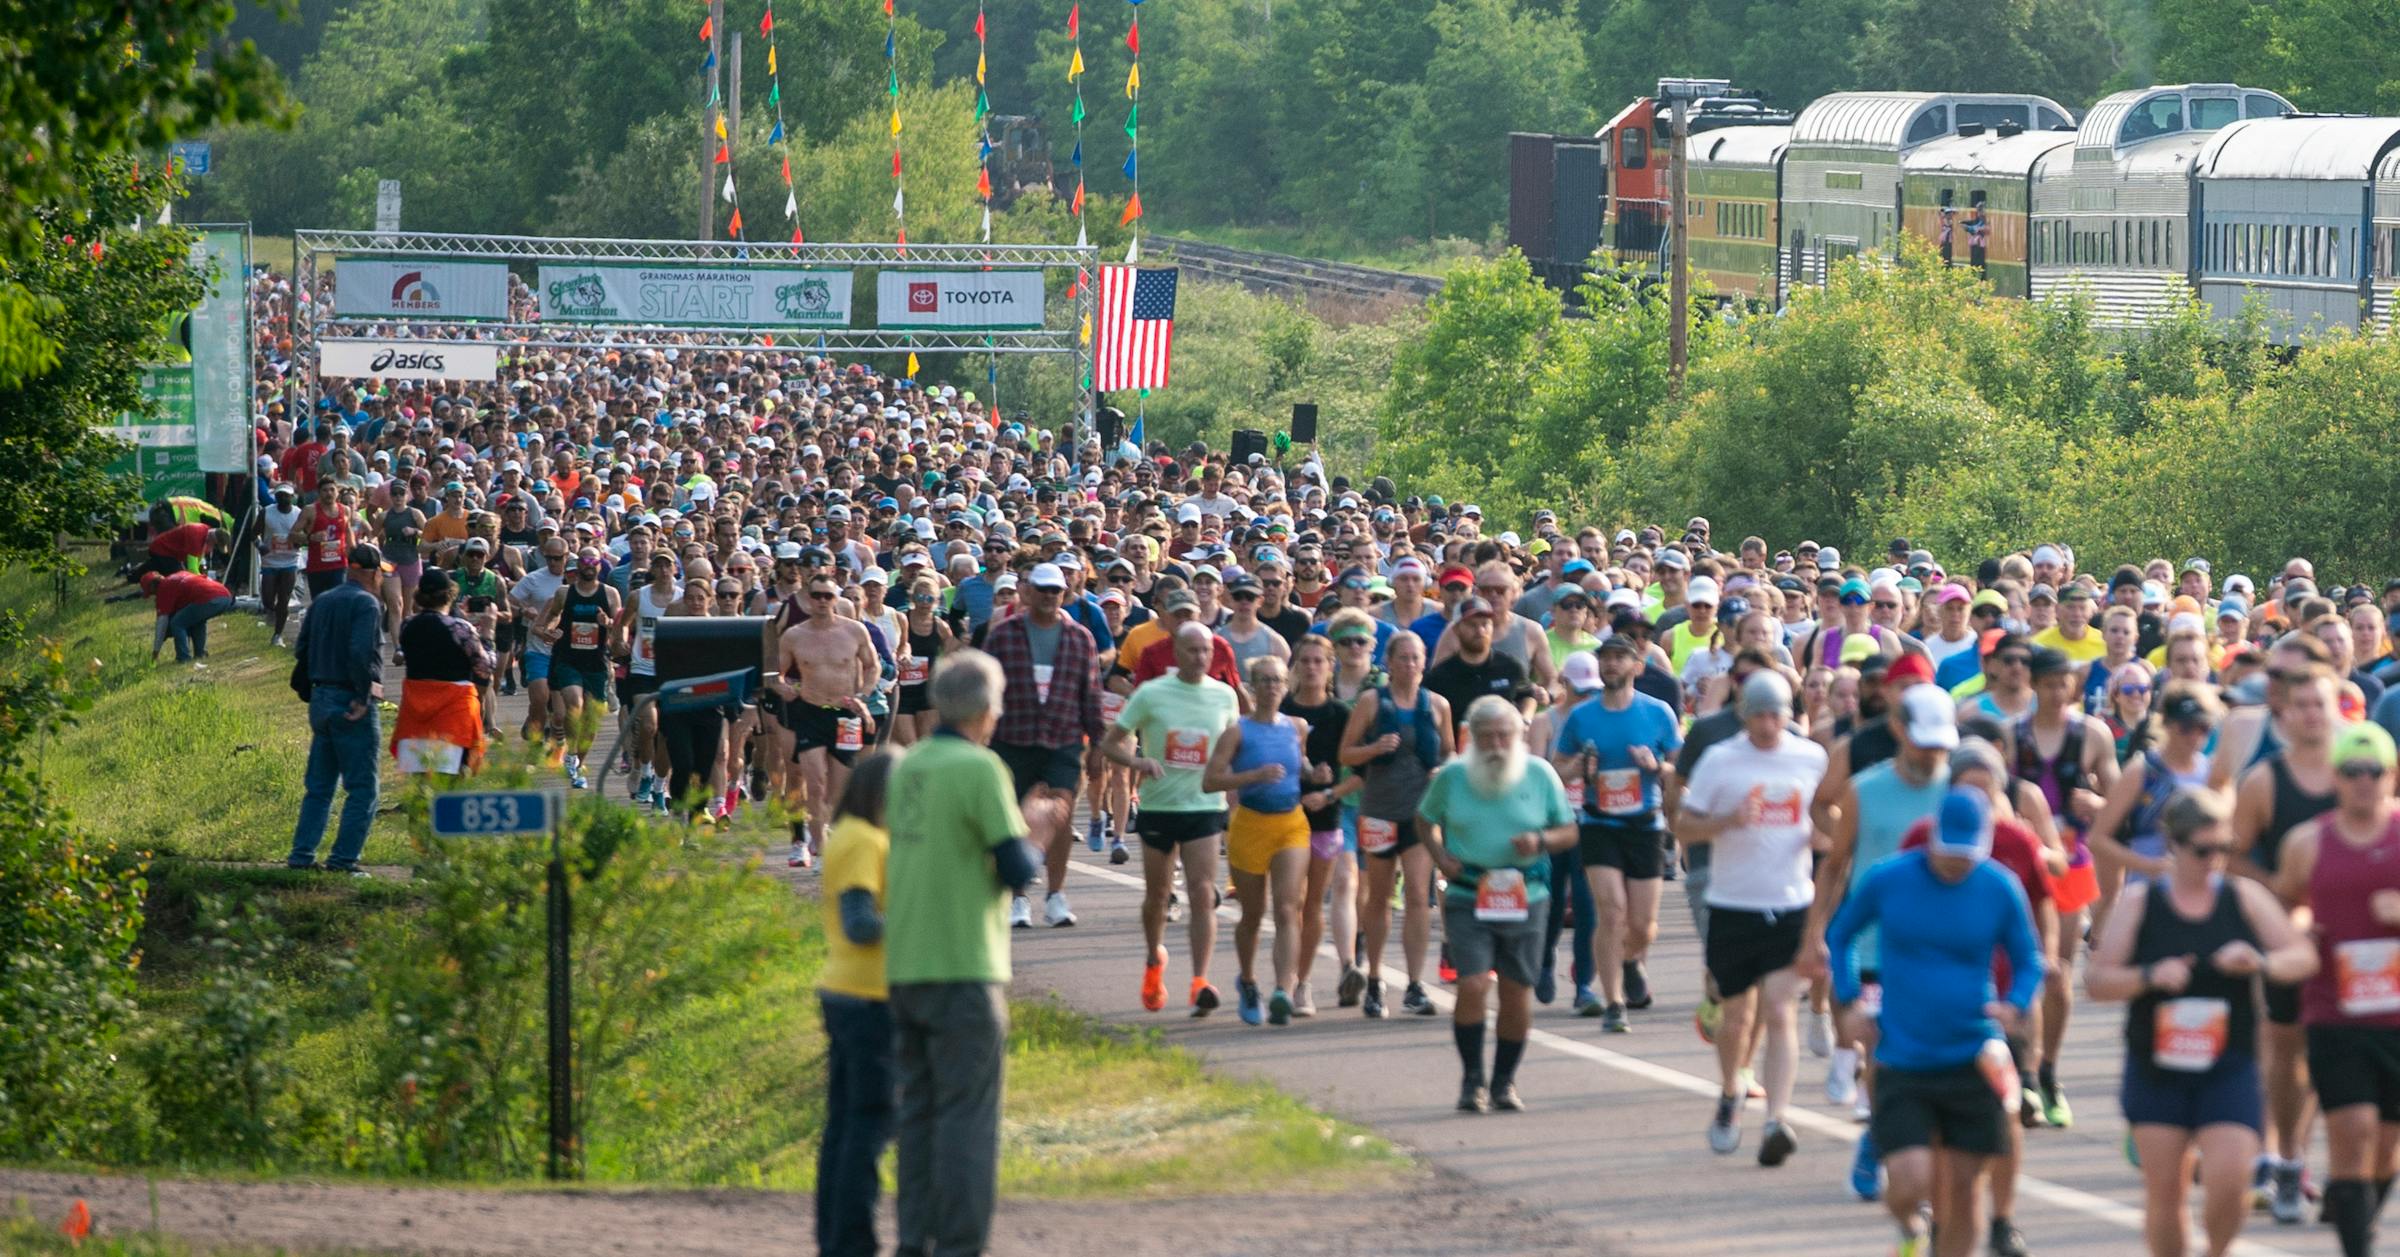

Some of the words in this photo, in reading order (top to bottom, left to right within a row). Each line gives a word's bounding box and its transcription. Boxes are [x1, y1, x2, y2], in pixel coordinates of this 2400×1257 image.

[639, 271, 695, 281] GRANDMAS
[696, 273, 751, 282] MARATHON
[639, 283, 754, 319] START
[945, 291, 1014, 304] TOYOTA
[392, 301, 441, 309] MEMBERS
[560, 304, 618, 316] Marathon
[785, 308, 843, 319] Marathon
[395, 353, 444, 370] asics
[461, 797, 520, 830] 853
